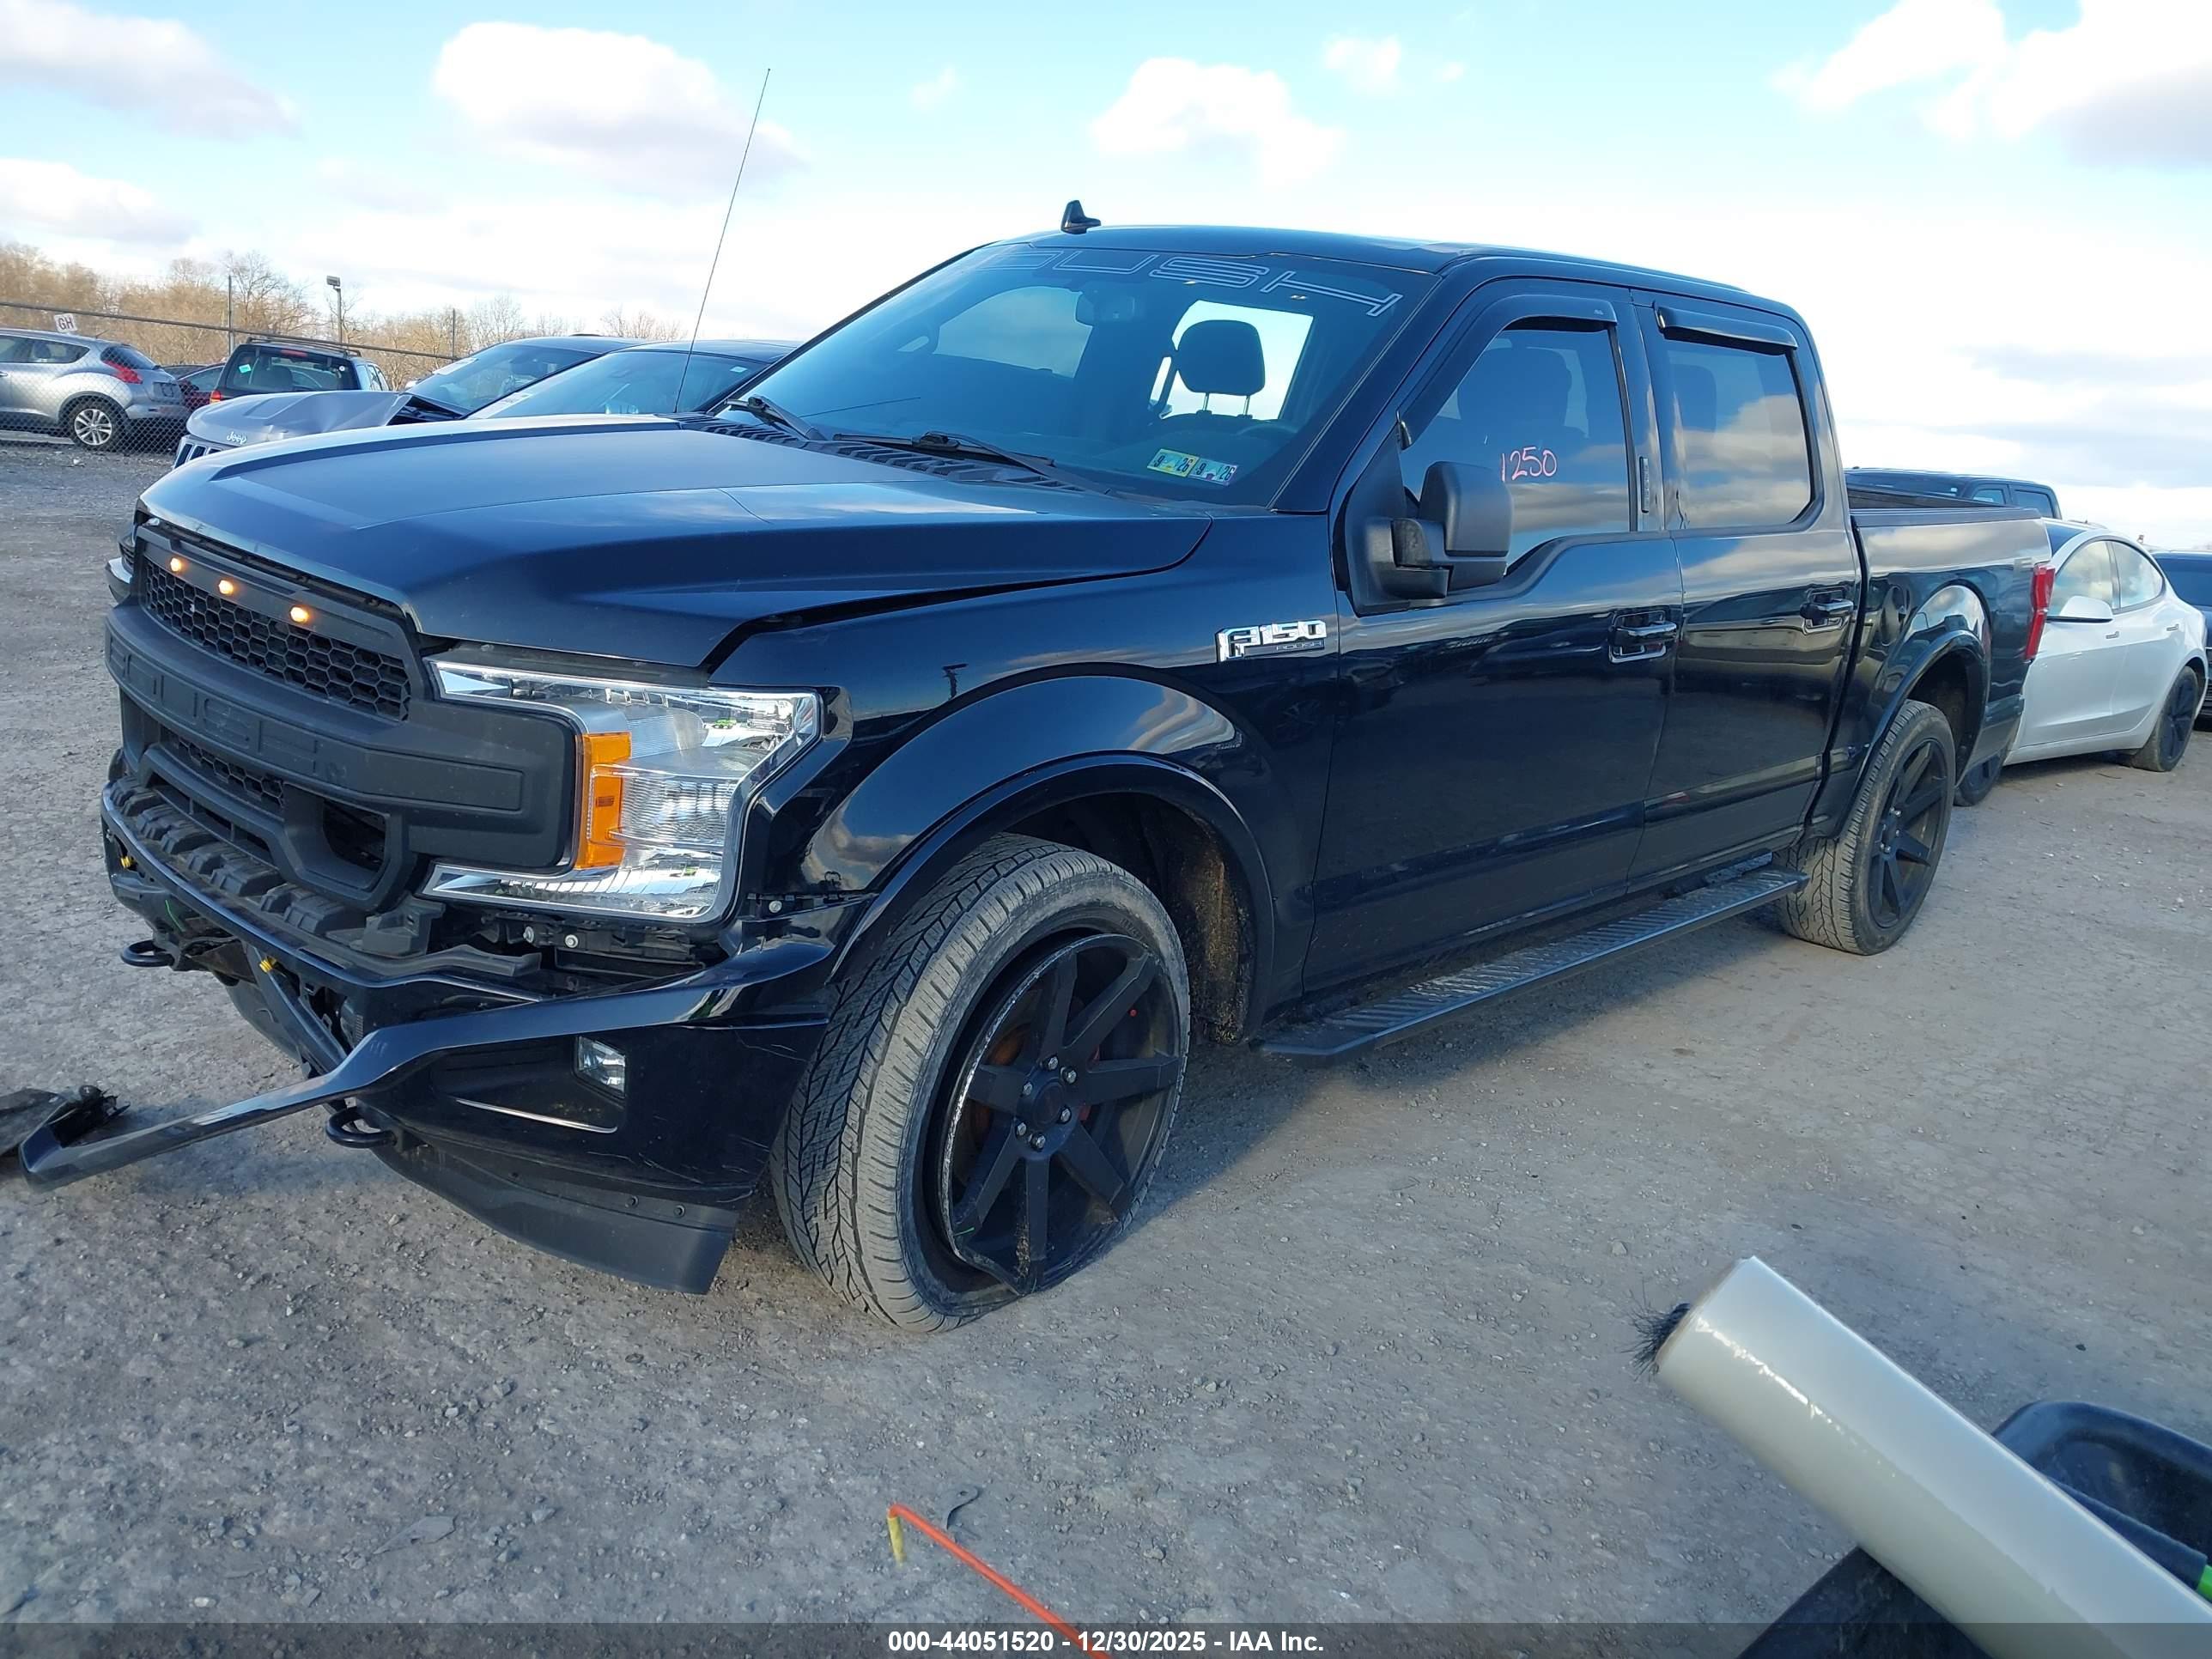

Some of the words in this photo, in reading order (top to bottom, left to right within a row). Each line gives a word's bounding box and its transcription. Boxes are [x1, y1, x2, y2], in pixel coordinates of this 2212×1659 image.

[58, 317, 75, 330] GH
[226, 430, 247, 445] Jeep
[1176, 457, 1194, 473] 26
[1501, 446, 1558, 482] 1250
[1218, 465, 1236, 481] 26
[1276, 641, 1322, 651] ROUSH
